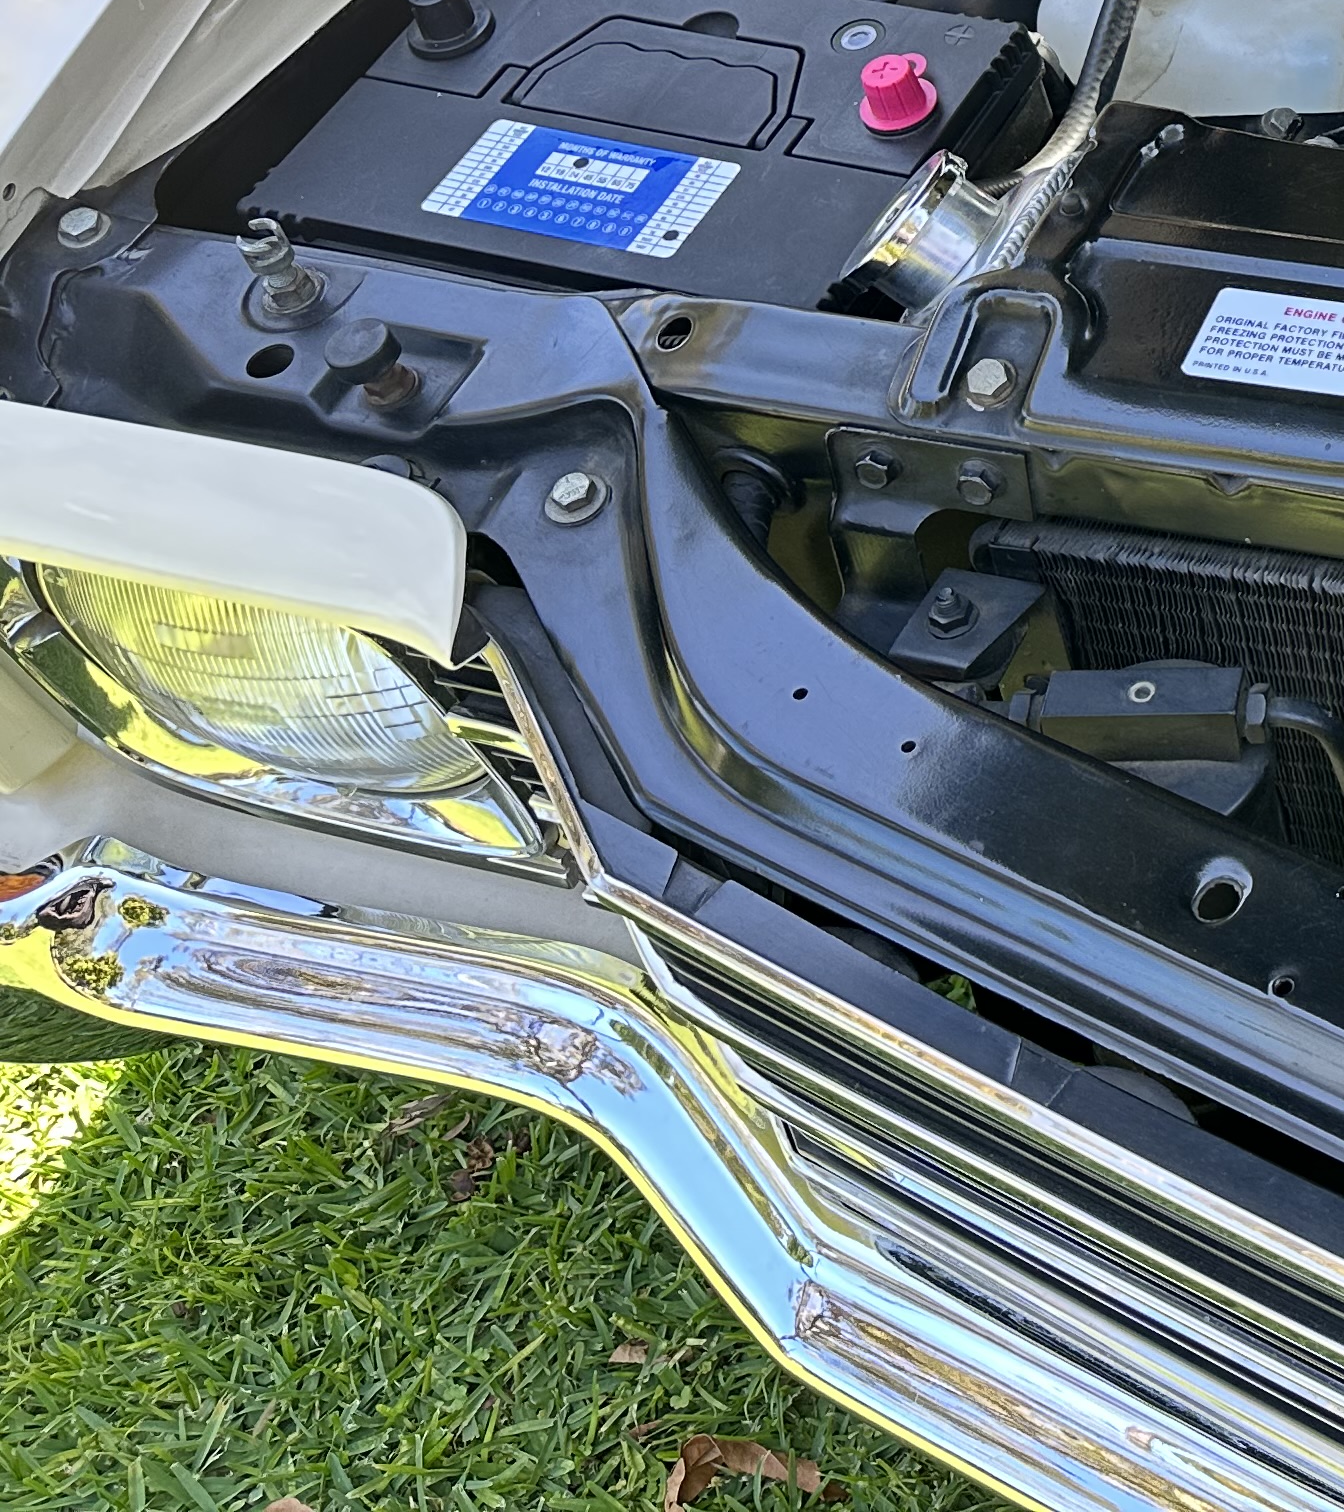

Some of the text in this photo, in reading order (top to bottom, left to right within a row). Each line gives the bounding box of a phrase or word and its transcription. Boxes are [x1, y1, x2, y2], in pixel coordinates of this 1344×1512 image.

[557, 141, 657, 166] MONTHS OF WARRANTY
[527, 178, 624, 203] INSTALLATION DATE
[1283, 307, 1337, 321] ENGINE
[1214, 315, 1271, 329] ORIGINAL
[1273, 323, 1328, 336] FACTORY
[1203, 335, 1279, 352] PROTECTION
[1281, 346, 1314, 356] MUST
[1316, 350, 1332, 359] BE
[1209, 325, 1267, 339] FREEZING
[1269, 333, 1344, 350] PROTECTION
[1198, 345, 1224, 355] FOR
[1226, 349, 1274, 362] PROPER
[1191, 360, 1230, 370] PRINTED
